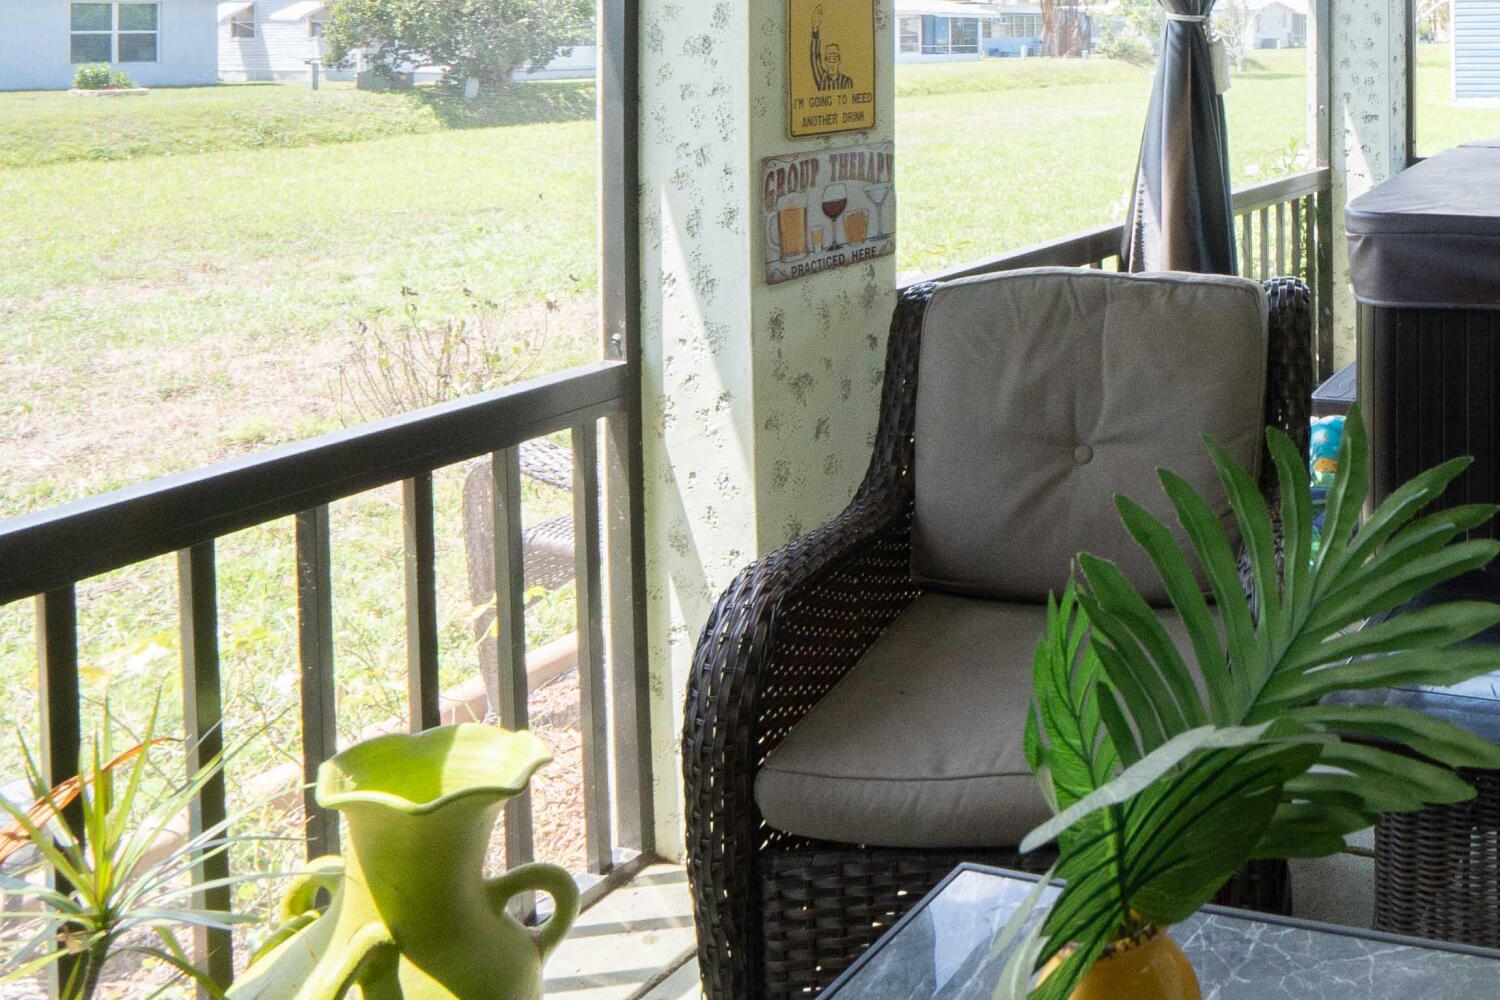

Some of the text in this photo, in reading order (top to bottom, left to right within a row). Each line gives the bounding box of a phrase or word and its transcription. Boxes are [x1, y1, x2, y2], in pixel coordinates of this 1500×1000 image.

[794, 92, 872, 110] I'M GOING TO NEED
[802, 111, 865, 127] ANOTHER DRINK
[829, 151, 894, 183] THERAPY
[791, 246, 877, 278] PRACTICED HERE
